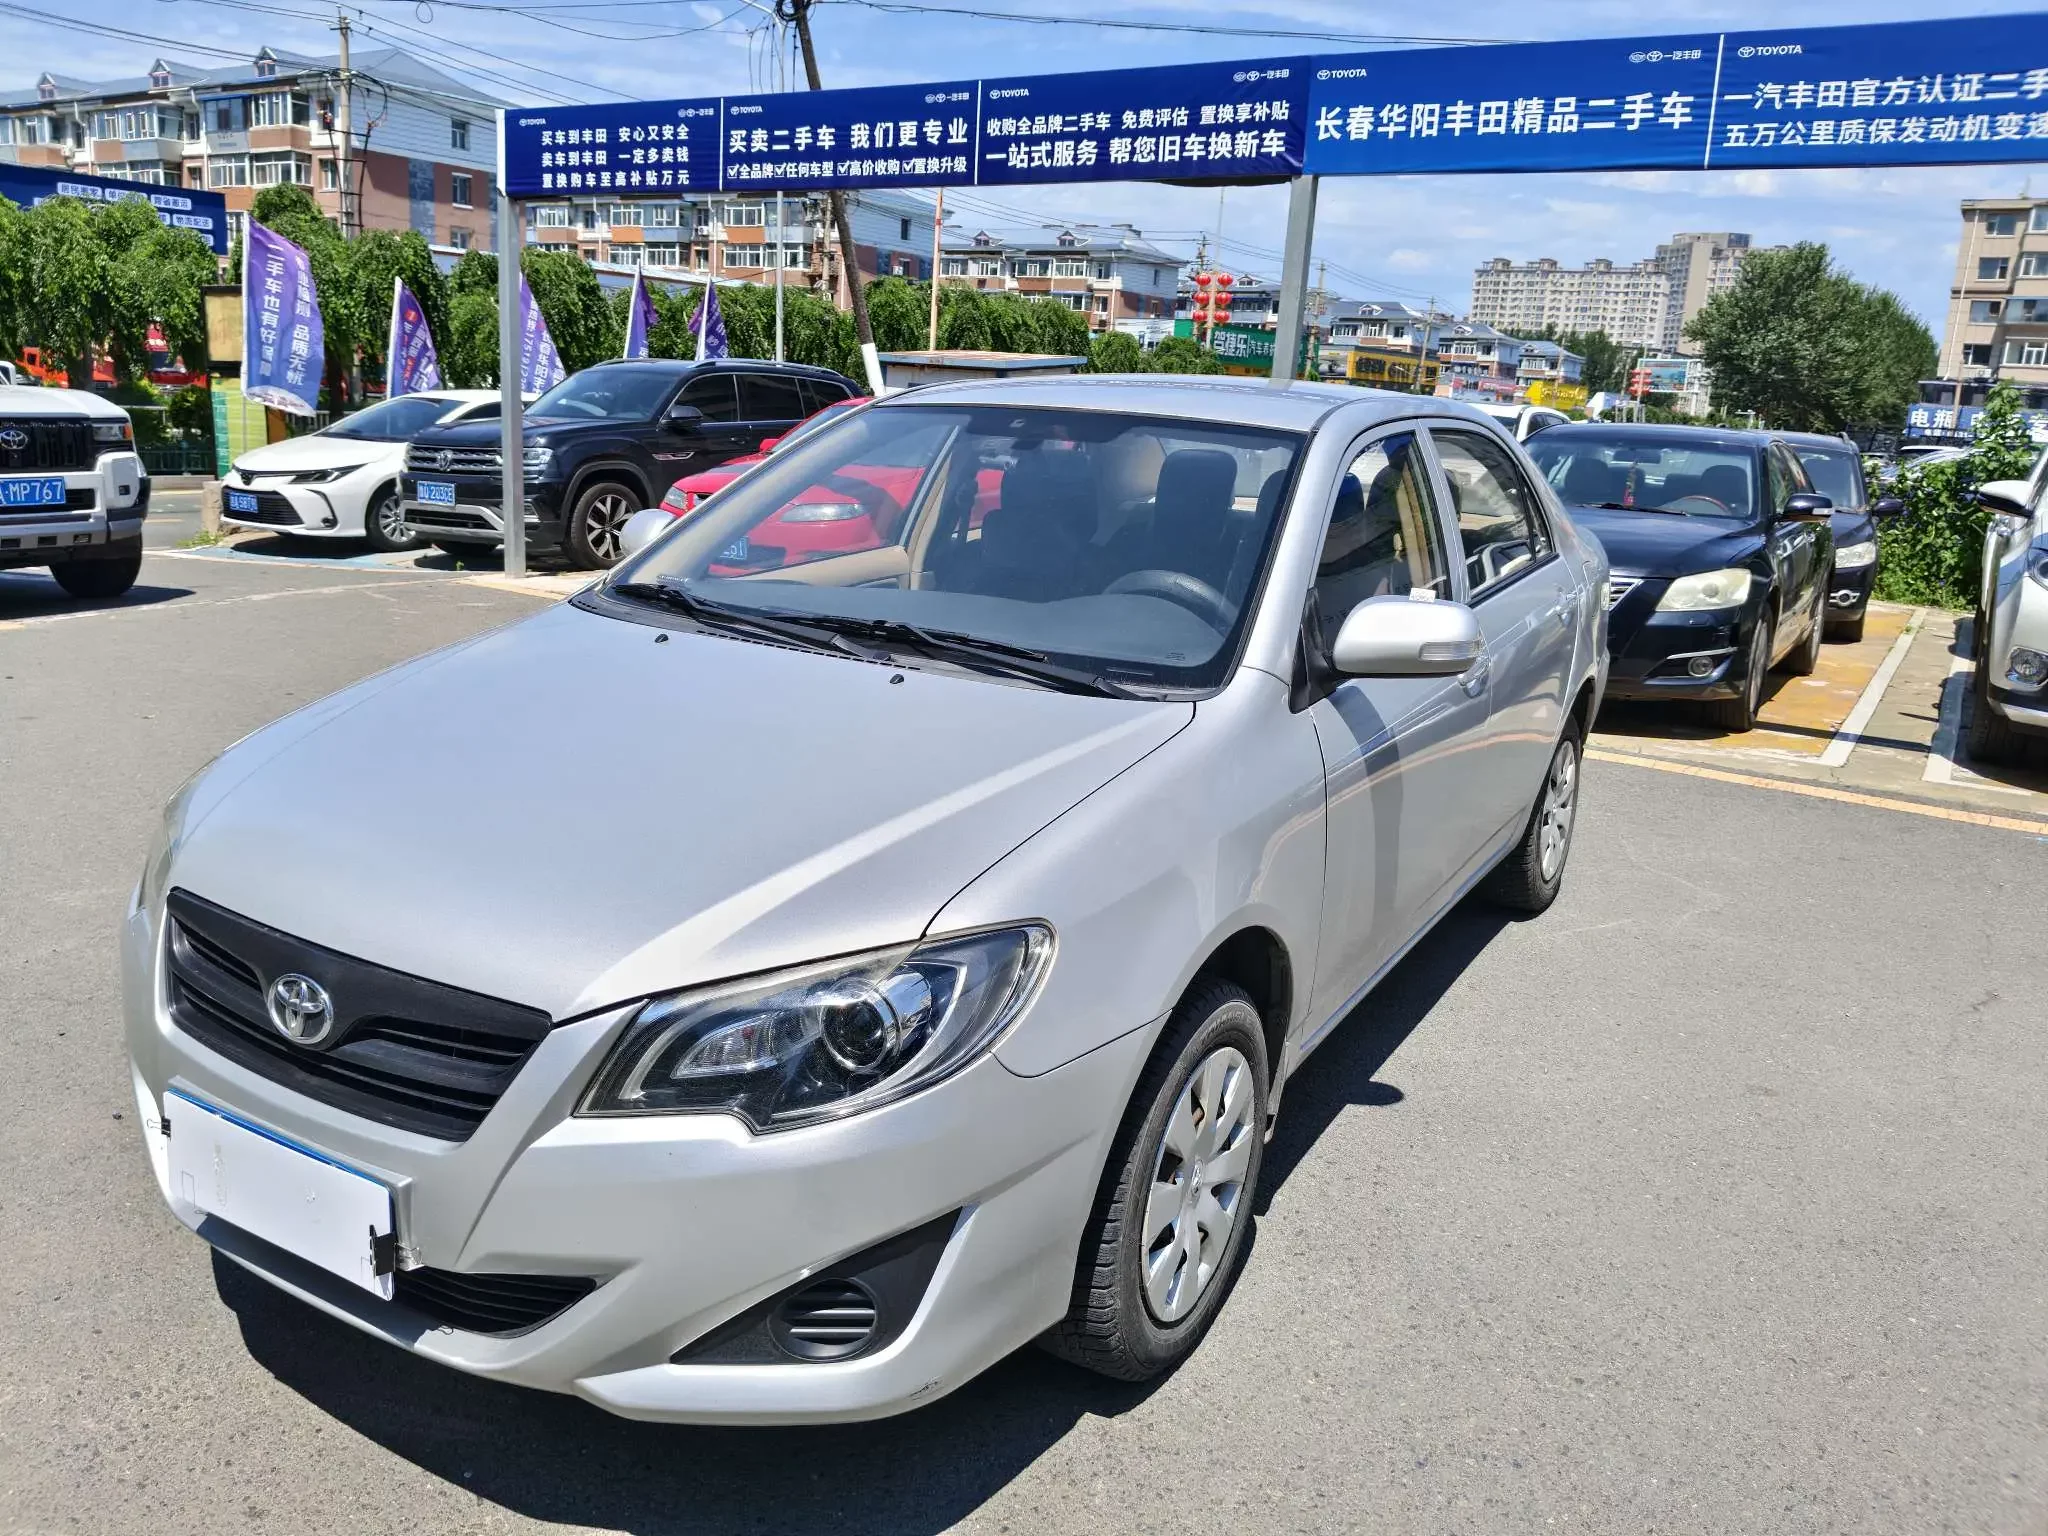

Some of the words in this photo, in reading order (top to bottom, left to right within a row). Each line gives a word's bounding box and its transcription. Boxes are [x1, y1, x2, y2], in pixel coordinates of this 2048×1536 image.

[1661, 50, 1702, 61] 一汽丰田
[1757, 44, 1803, 56] TOYOTA
[1331, 69, 1367, 79] TOYOTA
[1001, 89, 1029, 98] TOYOTA
[1724, 68, 2048, 110] 一汽丰田官方认证二手
[740, 106, 763, 114] TOYOTA
[986, 112, 1111, 137] 收购全品牌二手车
[1122, 107, 1189, 130] 免费评估
[1200, 100, 1289, 124] 置换享补贴
[1315, 91, 1695, 141] 长春华阳丰田精品二手车
[541, 128, 607, 146] 买车到丰田
[619, 123, 690, 143] 安心又安全
[729, 124, 836, 154] 买卖二手车
[850, 117, 968, 149] 我们更专业
[541, 150, 607, 168] 卖车到丰田
[619, 145, 690, 164] 一定多卖钱
[986, 138, 1098, 169] 一站式服务
[1109, 129, 1287, 165] 帮您旧车换新车
[740, 163, 774, 179] 全品牌
[786, 160, 834, 178] 任何车型
[850, 158, 901, 177] 高价收购
[913, 156, 967, 174] 置换升级
[542, 170, 690, 189] 置换购车至高补贴万元
[1911, 408, 1954, 428] 电瓶
